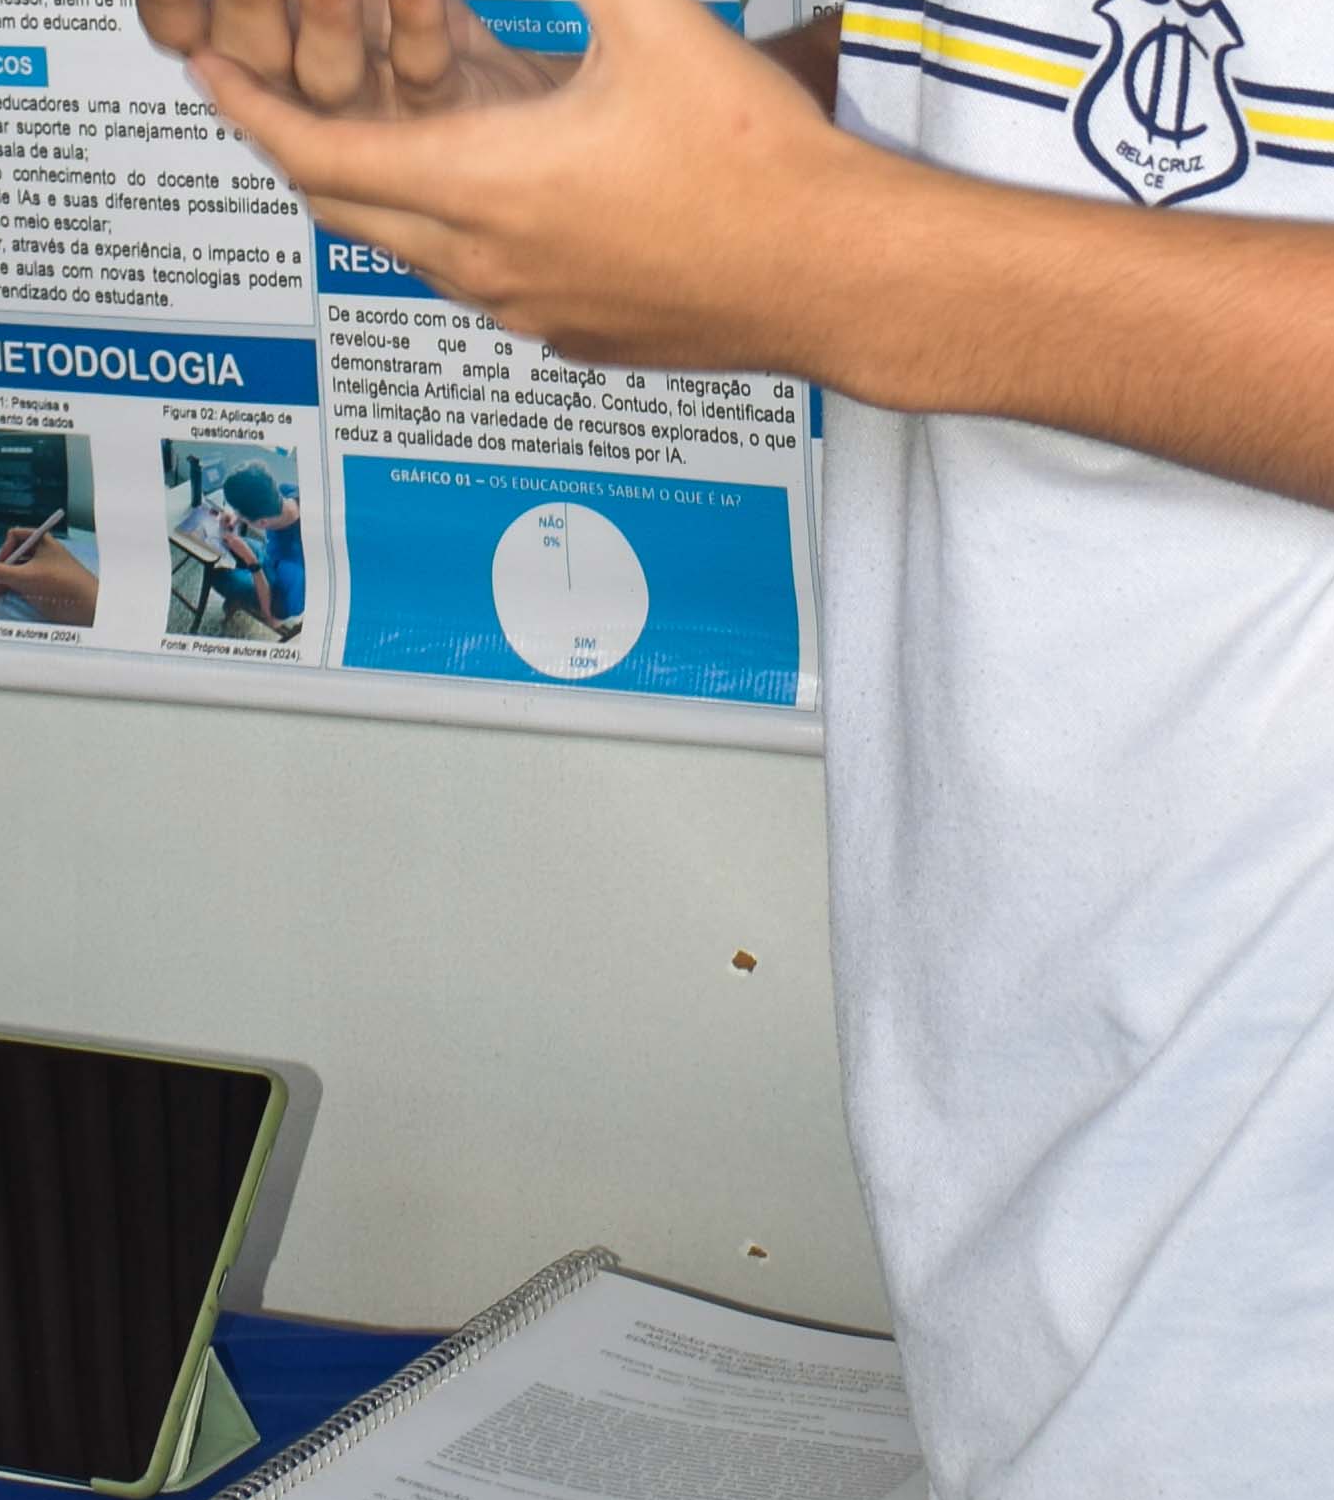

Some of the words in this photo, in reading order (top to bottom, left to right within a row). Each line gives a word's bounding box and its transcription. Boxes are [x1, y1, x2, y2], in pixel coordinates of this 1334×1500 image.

[479, 16, 542, 34] trevista
[1115, 140, 1155, 171] BELA
[1159, 156, 1205, 173] CRUZ
[1143, 173, 1164, 189] CE
[328, 243, 411, 275] RESU
[334, 424, 379, 443] reduz
[383, 430, 393, 444] a
[397, 429, 473, 449] qualidade
[477, 432, 507, 451] dos
[511, 437, 584, 456] materiais
[588, 439, 631, 460] feitos
[635, 447, 661, 465] por
[665, 446, 687, 465] IA.
[390, 467, 452, 485] GRÁFICO
[455, 472, 471, 487] 01
[489, 475, 508, 489] OS
[511, 476, 604, 495] EDUCADORES
[608, 483, 655, 500] SABEM
[659, 488, 670, 501] O
[674, 489, 703, 505] QUE
[708, 490, 715, 505] É
[720, 493, 741, 507] IA?
[538, 515, 565, 530] NÃO
